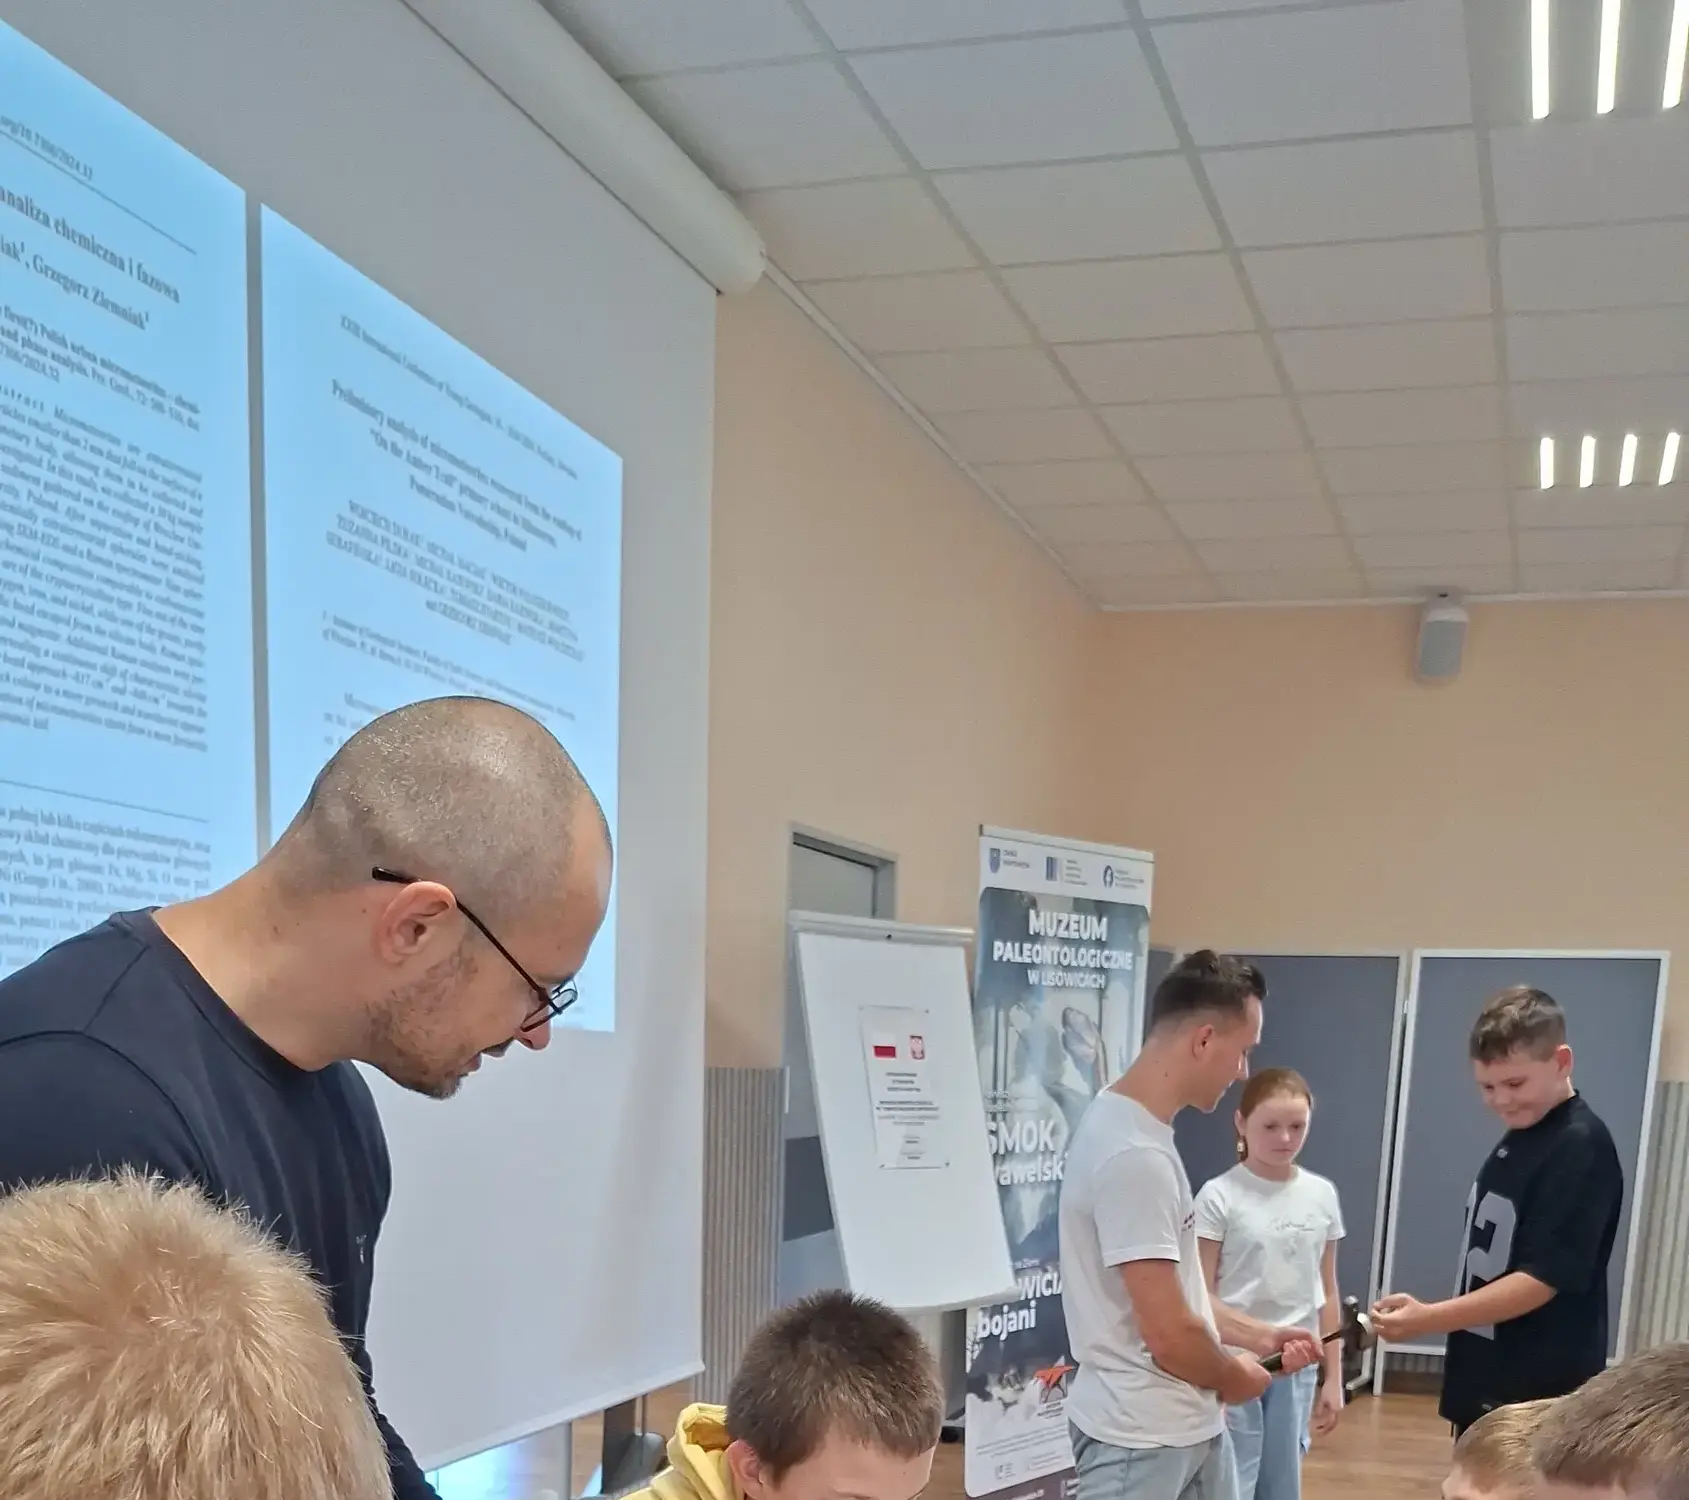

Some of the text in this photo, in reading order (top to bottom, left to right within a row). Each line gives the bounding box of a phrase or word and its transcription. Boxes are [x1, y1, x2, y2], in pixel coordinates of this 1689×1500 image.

[33, 254, 89, 300] Grzegorz
[54, 217, 125, 272] chemiczna
[137, 262, 180, 304] fazowa
[1028, 908, 1108, 943] MUZEUM
[992, 940, 1134, 971] PALEONTOLOGICZNE
[1026, 968, 1040, 986] W
[977, 1299, 1036, 1341] bojani
